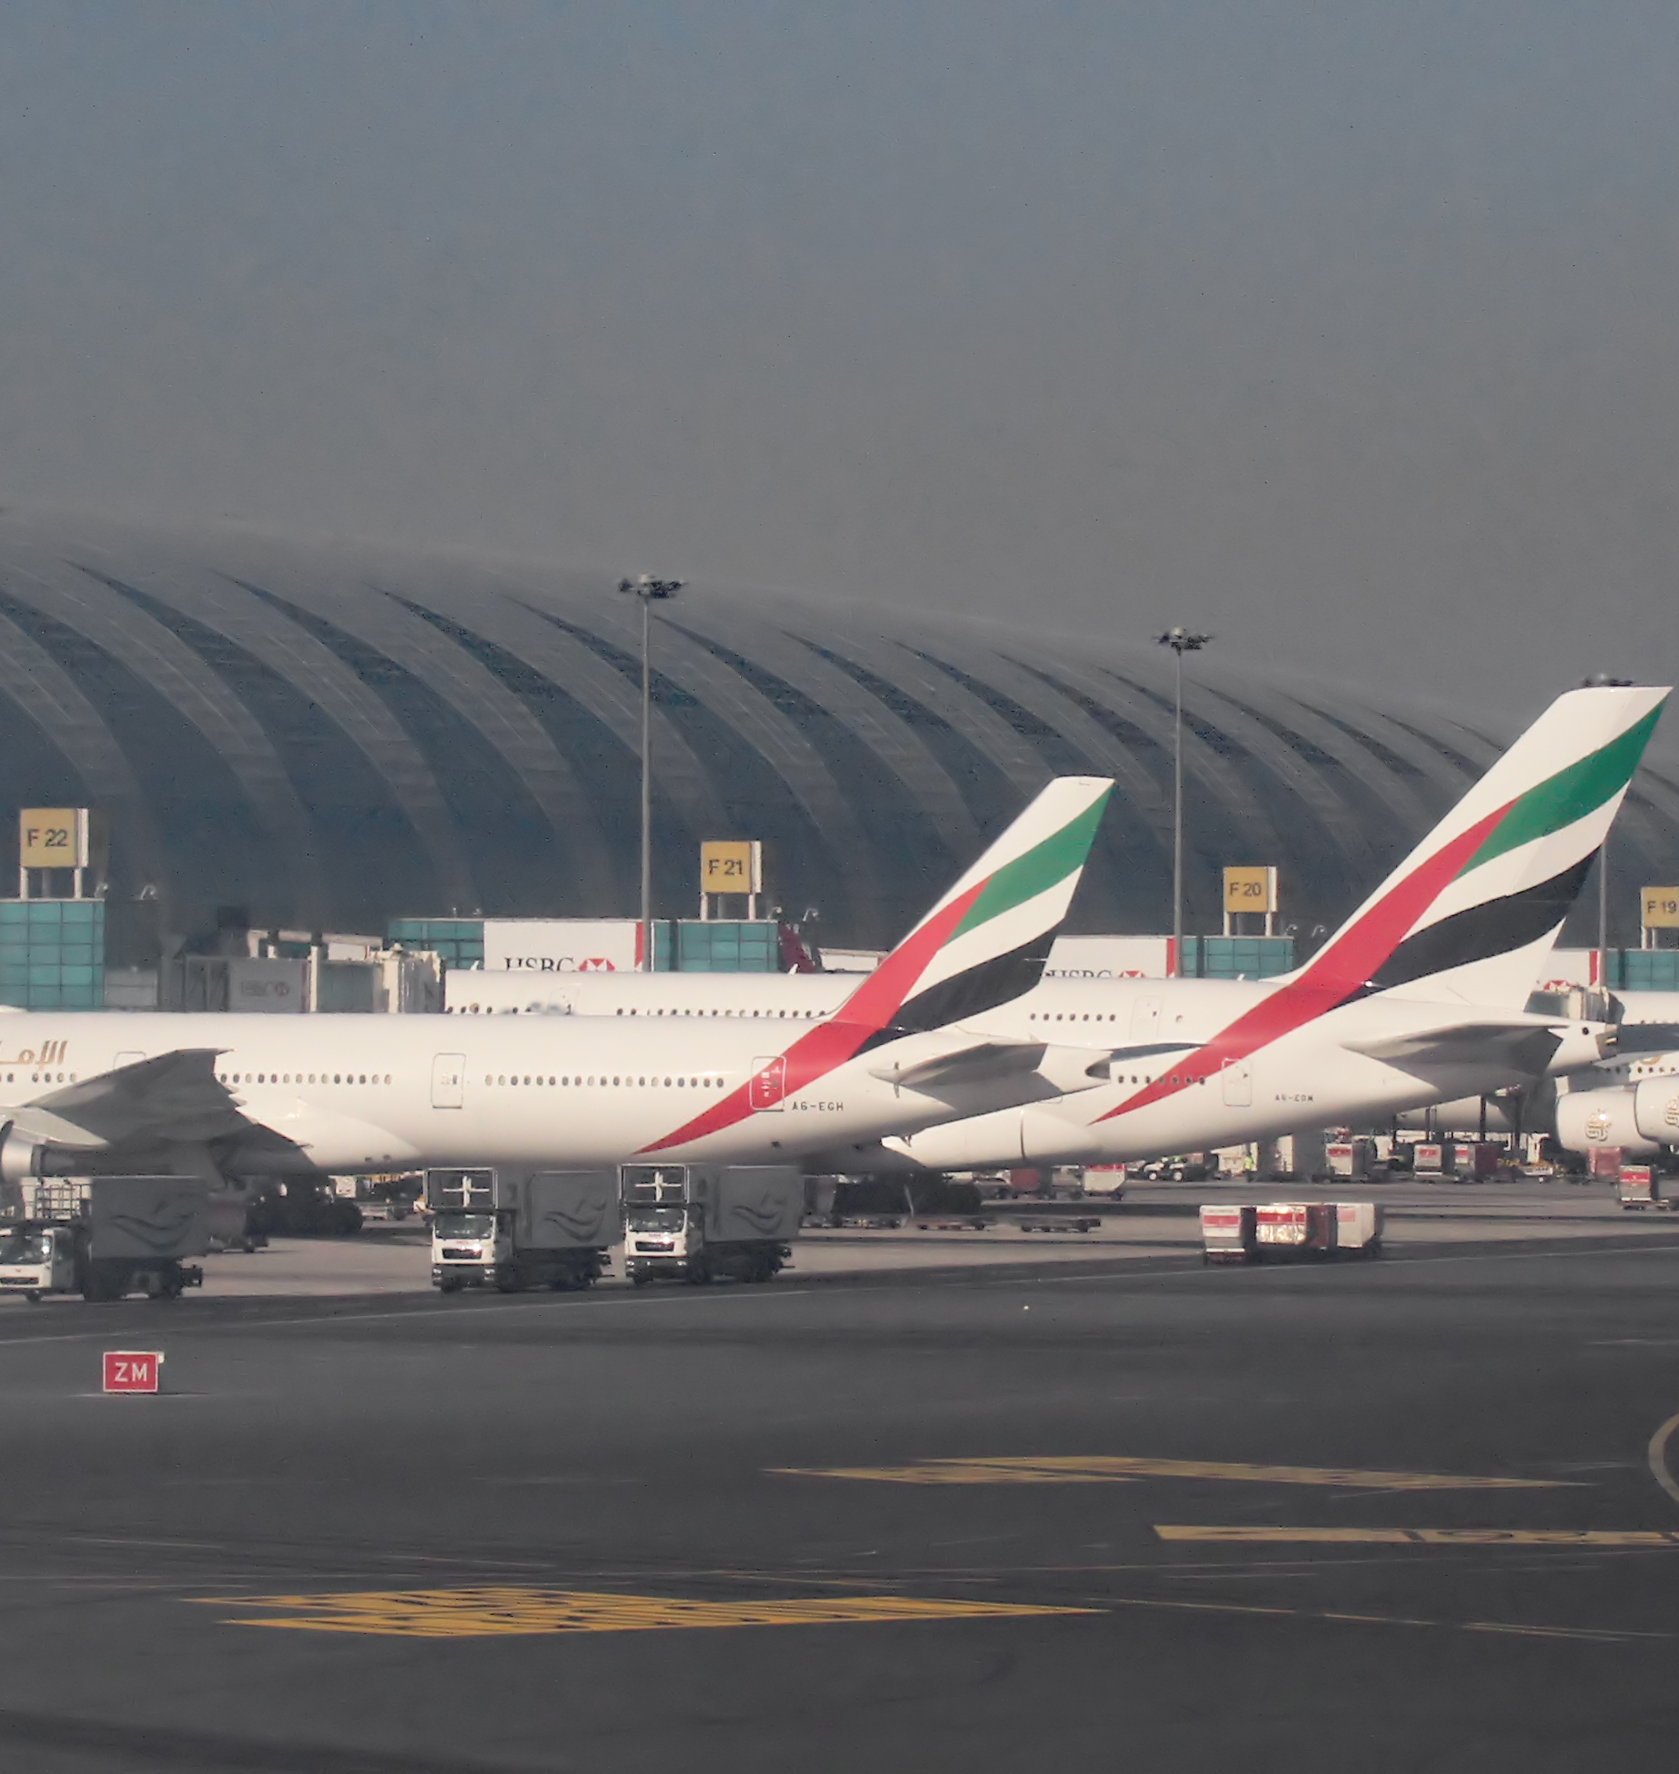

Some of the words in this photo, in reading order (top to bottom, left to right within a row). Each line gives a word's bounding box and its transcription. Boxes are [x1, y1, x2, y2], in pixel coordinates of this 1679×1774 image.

[27, 828, 39, 847] F
[45, 828, 68, 847] 22
[709, 859, 719, 875] F
[724, 859, 742, 875] 21
[1229, 882, 1239, 896] F
[1243, 882, 1261, 897] 20
[1647, 900, 1656, 914] F
[1661, 900, 1677, 914] 19
[792, 1101, 844, 1112] A6-EGH
[114, 1362, 148, 1382] ZM
